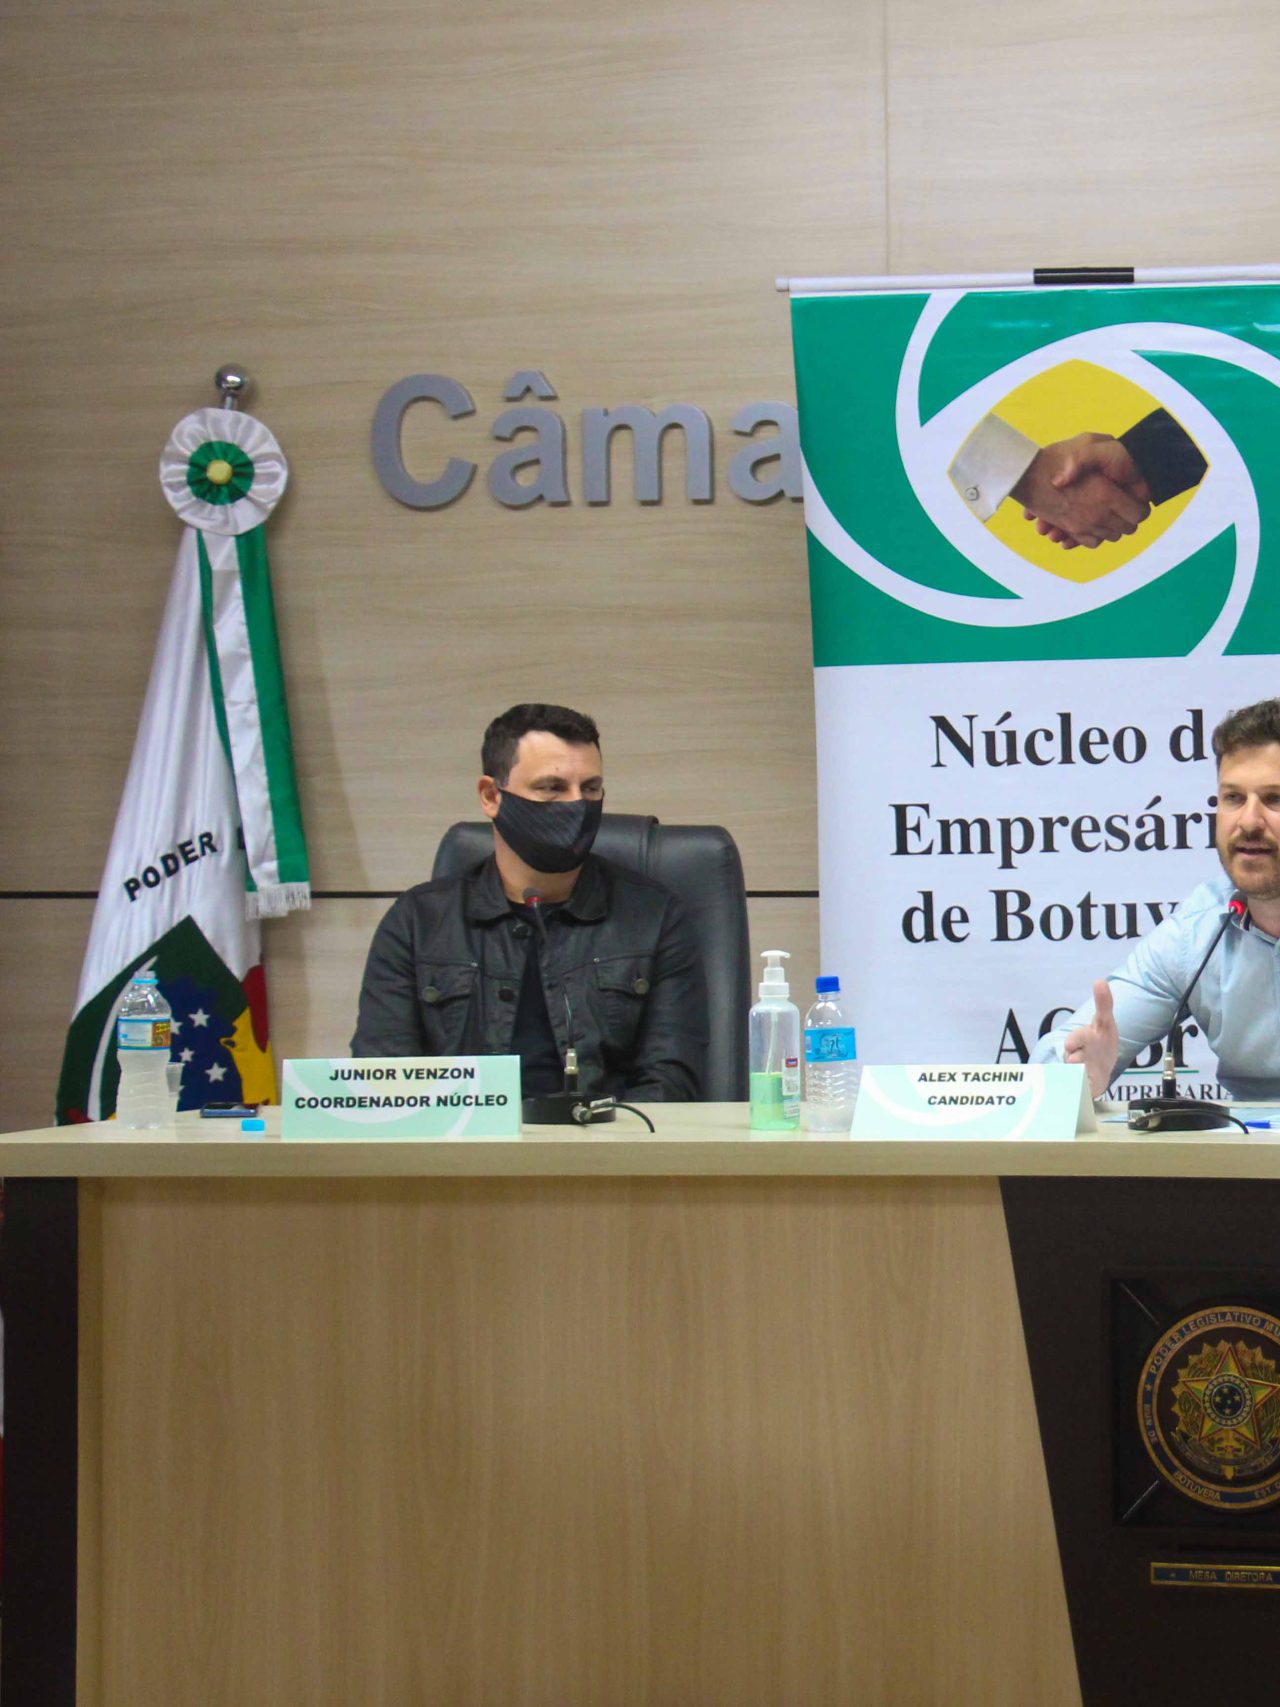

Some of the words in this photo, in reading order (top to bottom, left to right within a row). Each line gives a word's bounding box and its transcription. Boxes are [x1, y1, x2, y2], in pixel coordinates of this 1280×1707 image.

[930, 710, 1148, 768] Núcleo
[123, 831, 218, 902] PODER
[901, 890, 971, 943] de
[329, 1068, 397, 1081] JUNIOR
[402, 1067, 475, 1080] VENZON
[918, 1072, 957, 1082] ALEX
[963, 1072, 1024, 1082] TACHINI
[294, 1096, 431, 1109] COORDENADOR
[436, 1092, 508, 1107] NÚCLEO
[927, 1095, 1016, 1106] CANDIDATO
[1149, 1334, 1183, 1374] PODER
[1181, 1311, 1262, 1334] LEGISLATIVO
[1188, 1570, 1217, 1581] MESA
[1225, 1571, 1273, 1583] DIRETORA
